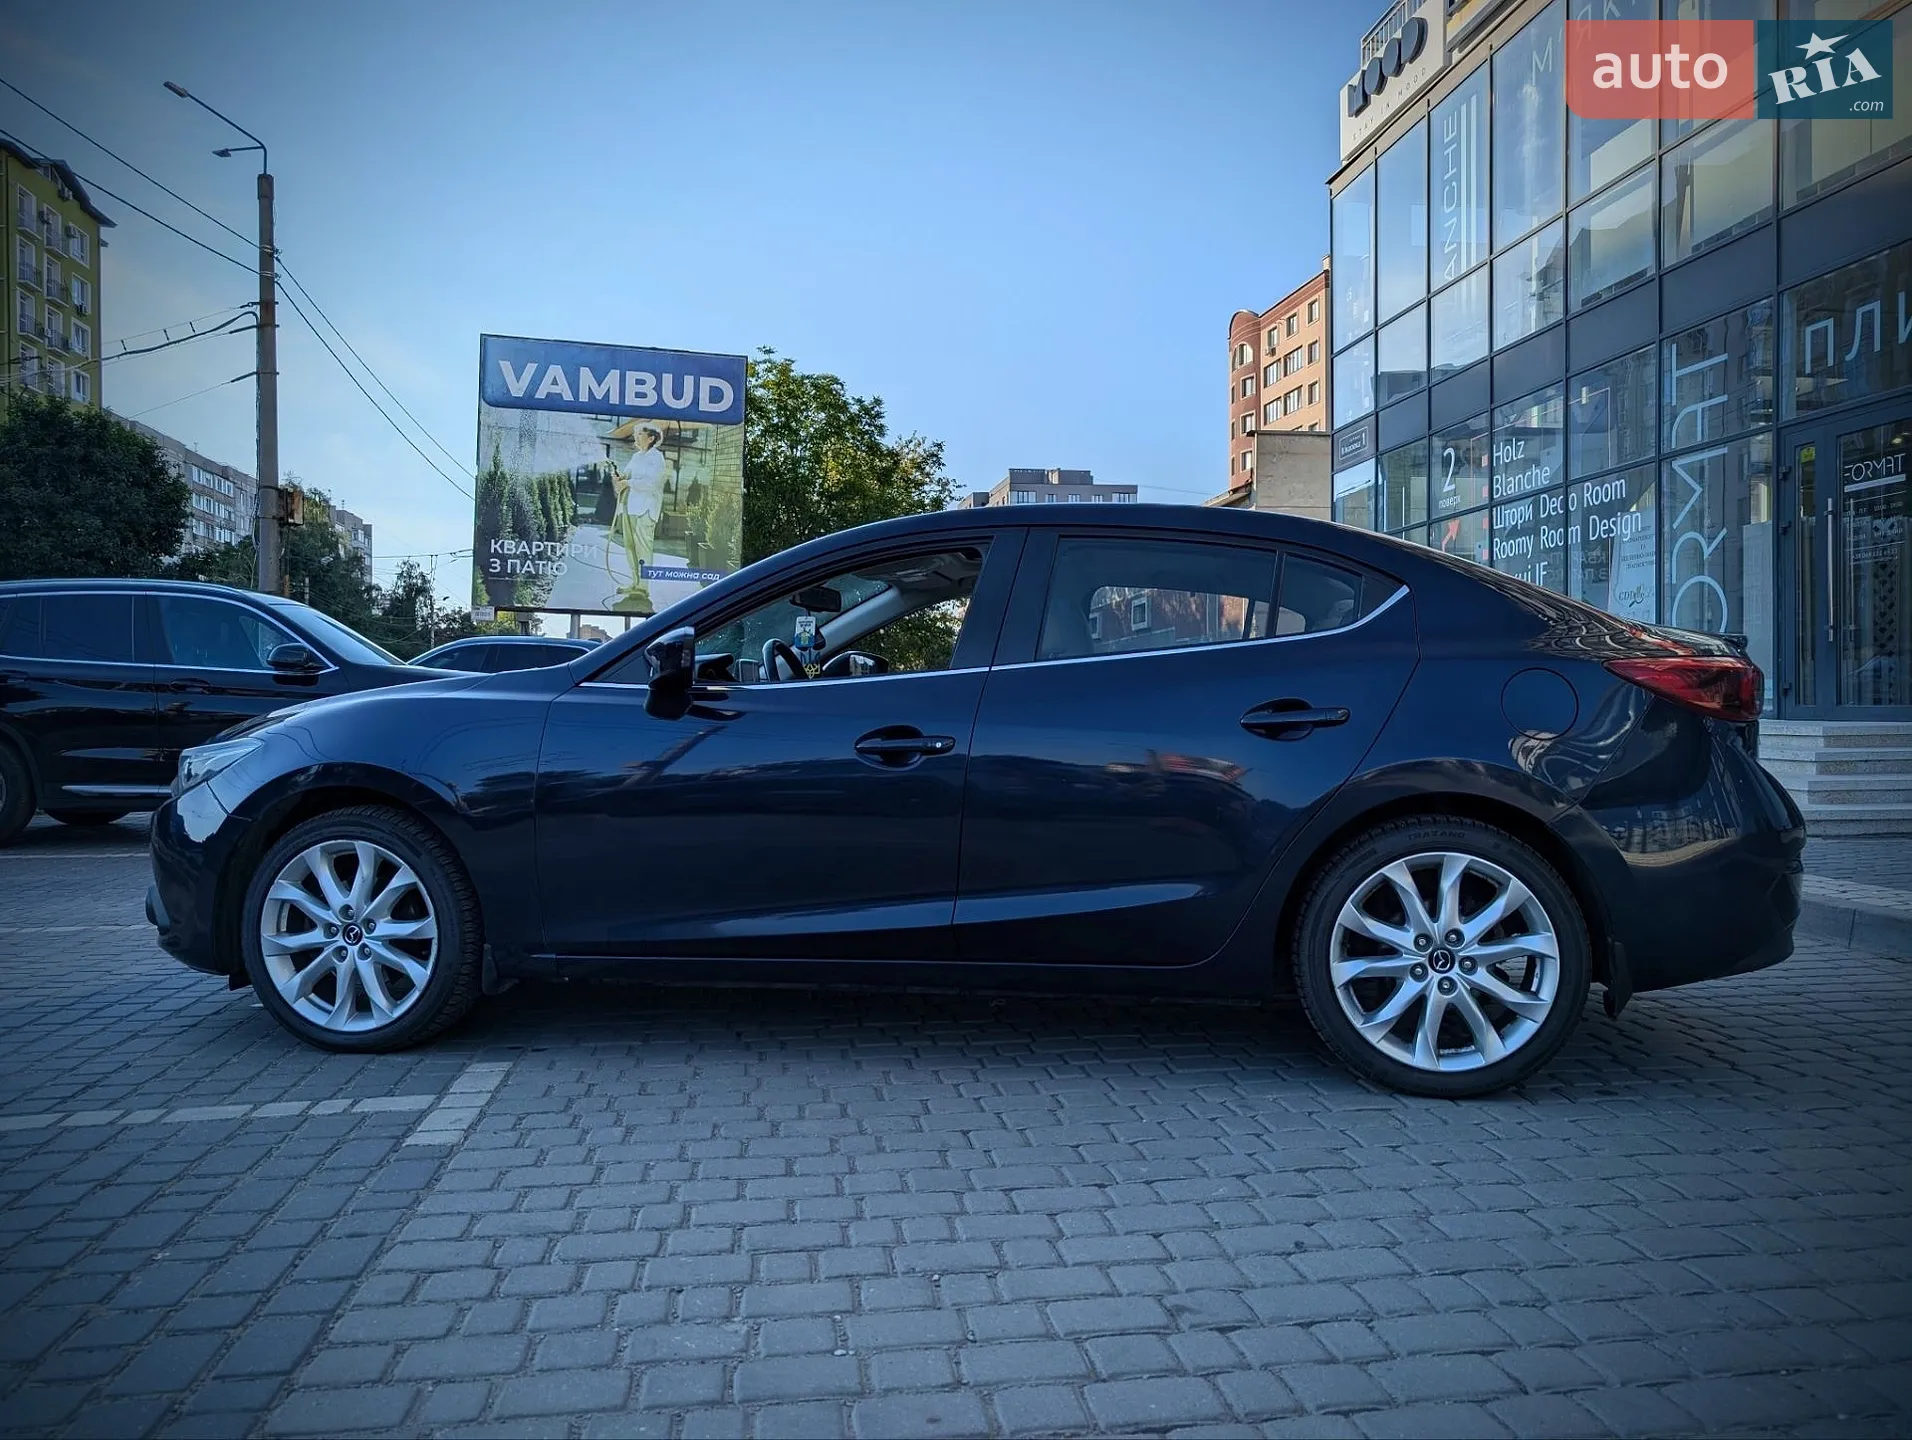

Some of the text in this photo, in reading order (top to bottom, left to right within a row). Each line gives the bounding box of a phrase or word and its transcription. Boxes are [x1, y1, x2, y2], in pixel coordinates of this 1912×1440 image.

[498, 360, 735, 413] VAMBUD
[1493, 437, 1525, 468] Holz
[1843, 452, 1907, 482] FORMAT
[1442, 447, 1456, 493] 2
[1493, 465, 1550, 499] Blanche
[1493, 502, 1533, 530] Штори
[1583, 478, 1626, 508] Room
[1672, 342, 1729, 633] ORMAT
[490, 538, 601, 559] КВАРТИРИ
[1493, 531, 1534, 561] Roomy
[1540, 525, 1581, 549] Room
[1589, 512, 1641, 542] Design
[488, 558, 568, 576] З ПАТІО
[648, 570, 664, 579] тут
[665, 570, 700, 580] можна
